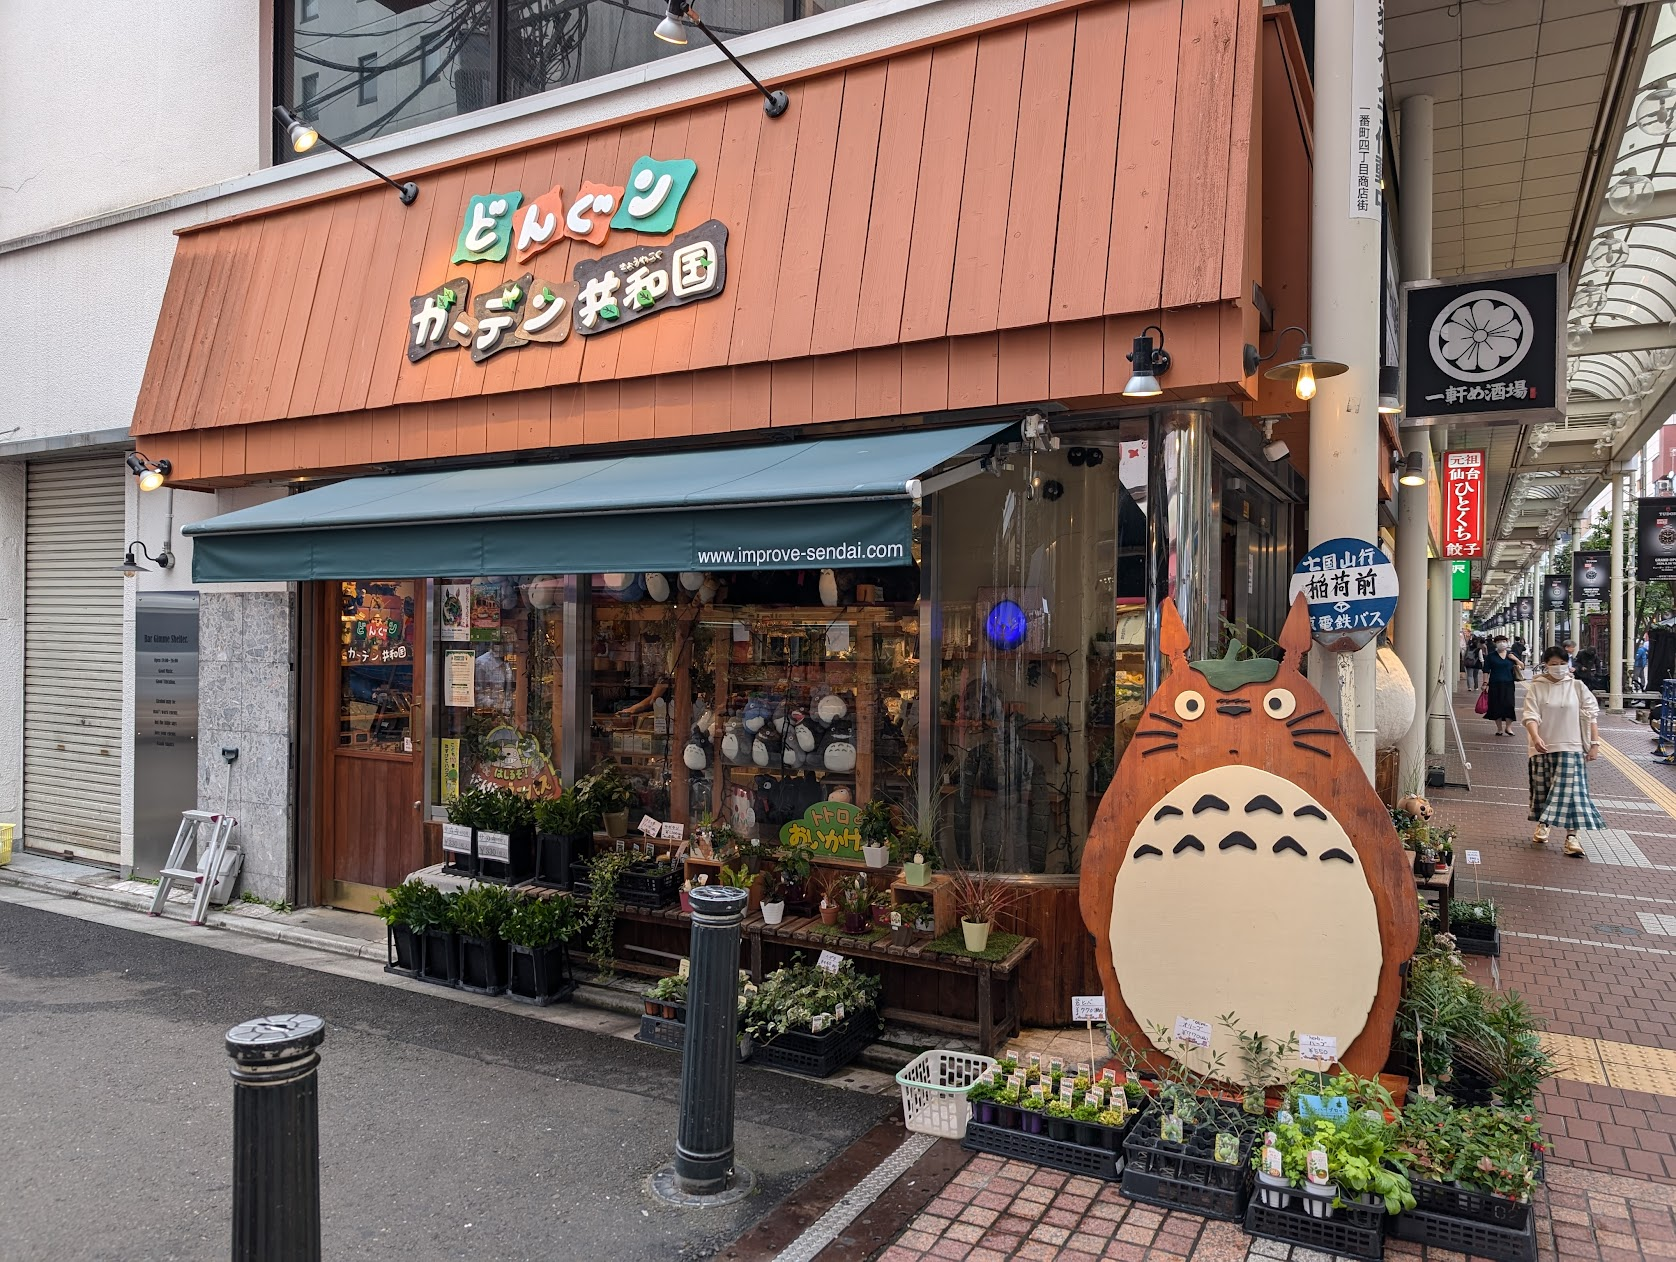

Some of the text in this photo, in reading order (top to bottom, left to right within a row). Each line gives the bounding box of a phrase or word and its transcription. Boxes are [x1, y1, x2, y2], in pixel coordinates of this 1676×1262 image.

[1357, 106, 1371, 211] 一番町四丁目商店街
[578, 241, 718, 329] 共和国
[1425, 380, 1528, 404] 一軒め酒場
[1450, 454, 1480, 465] 元祖
[1448, 467, 1481, 481] 仙台
[1454, 481, 1475, 541] ひとくち
[698, 542, 903, 566] www.improve-sendai.com
[1302, 548, 1376, 572] 七国山行
[1445, 543, 1481, 556] 餃子
[1305, 568, 1377, 600] 稲荷前
[494, 768, 529, 780] はしるぞ!
